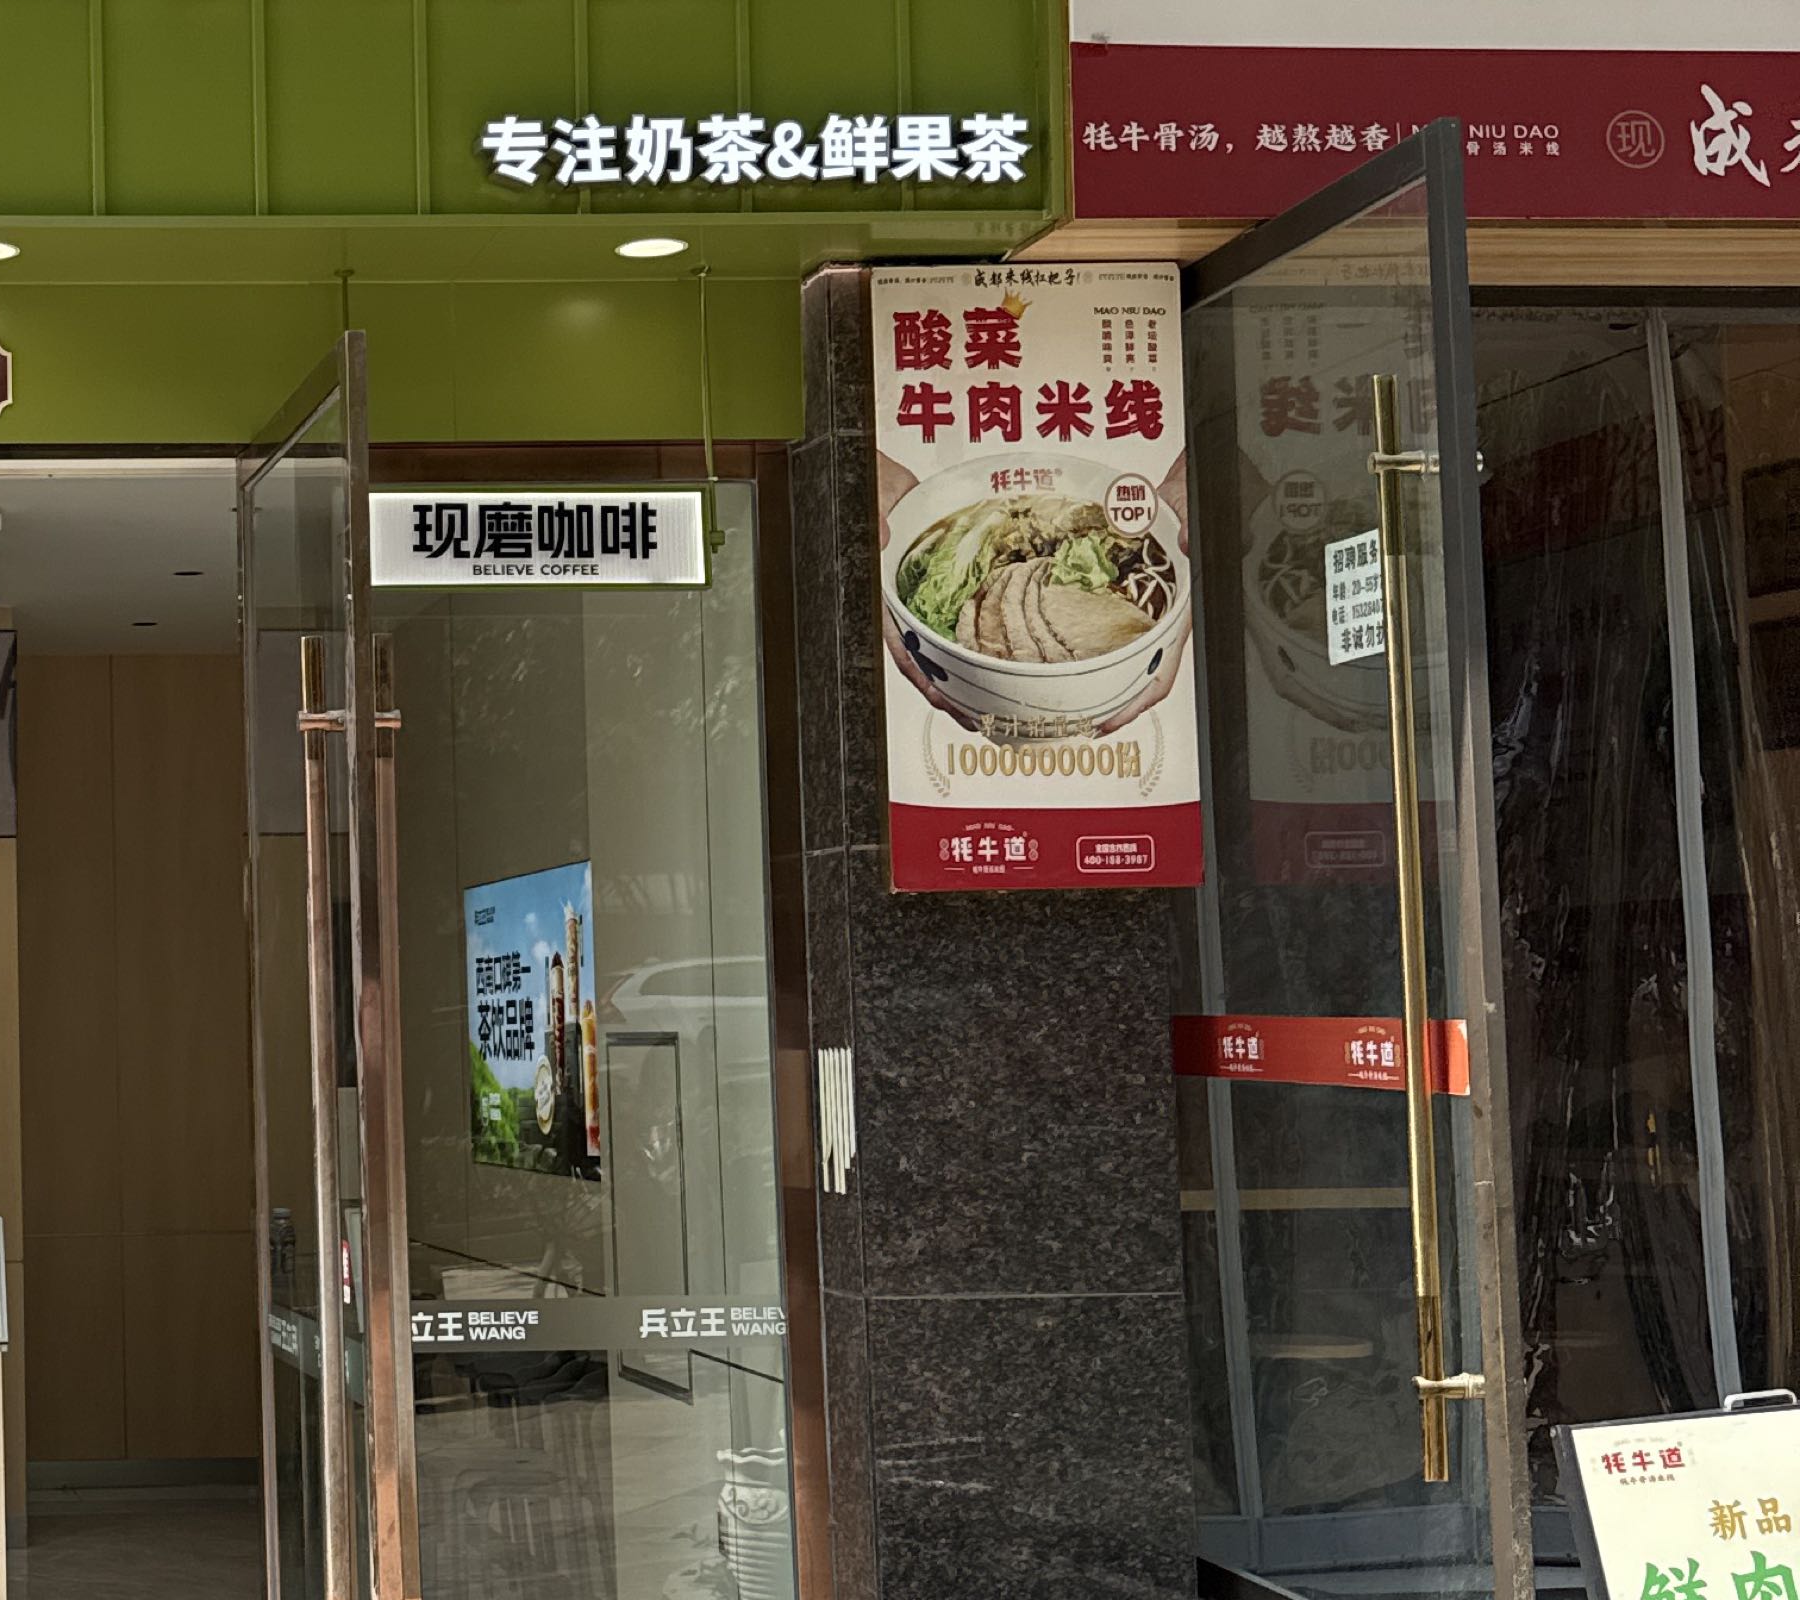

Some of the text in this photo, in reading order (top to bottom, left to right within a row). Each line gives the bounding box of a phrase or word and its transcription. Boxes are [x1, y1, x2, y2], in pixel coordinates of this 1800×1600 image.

[1082, 120, 1391, 155] 牦牛骨汤，越熬越香
[1468, 124, 1559, 139] NIU DAO
[1615, 119, 1655, 160] 现
[481, 113, 1029, 185] 专注奶茶&鲜果茶
[893, 306, 1022, 371] 酸菜
[896, 380, 1164, 443] 牛肉米线
[413, 501, 658, 559] 现磨咖啡
[473, 564, 599, 576] BELIEVE COFFEE
[951, 836, 1028, 863] 牦牛道
[468, 1311, 539, 1326] BELIEVE
[469, 1326, 526, 1341] WANG
[639, 1307, 727, 1339] 兵立王
[732, 1321, 787, 1337] WANG
[1601, 1446, 1686, 1475] 牦牛道
[1708, 1497, 1792, 1540] 新品
